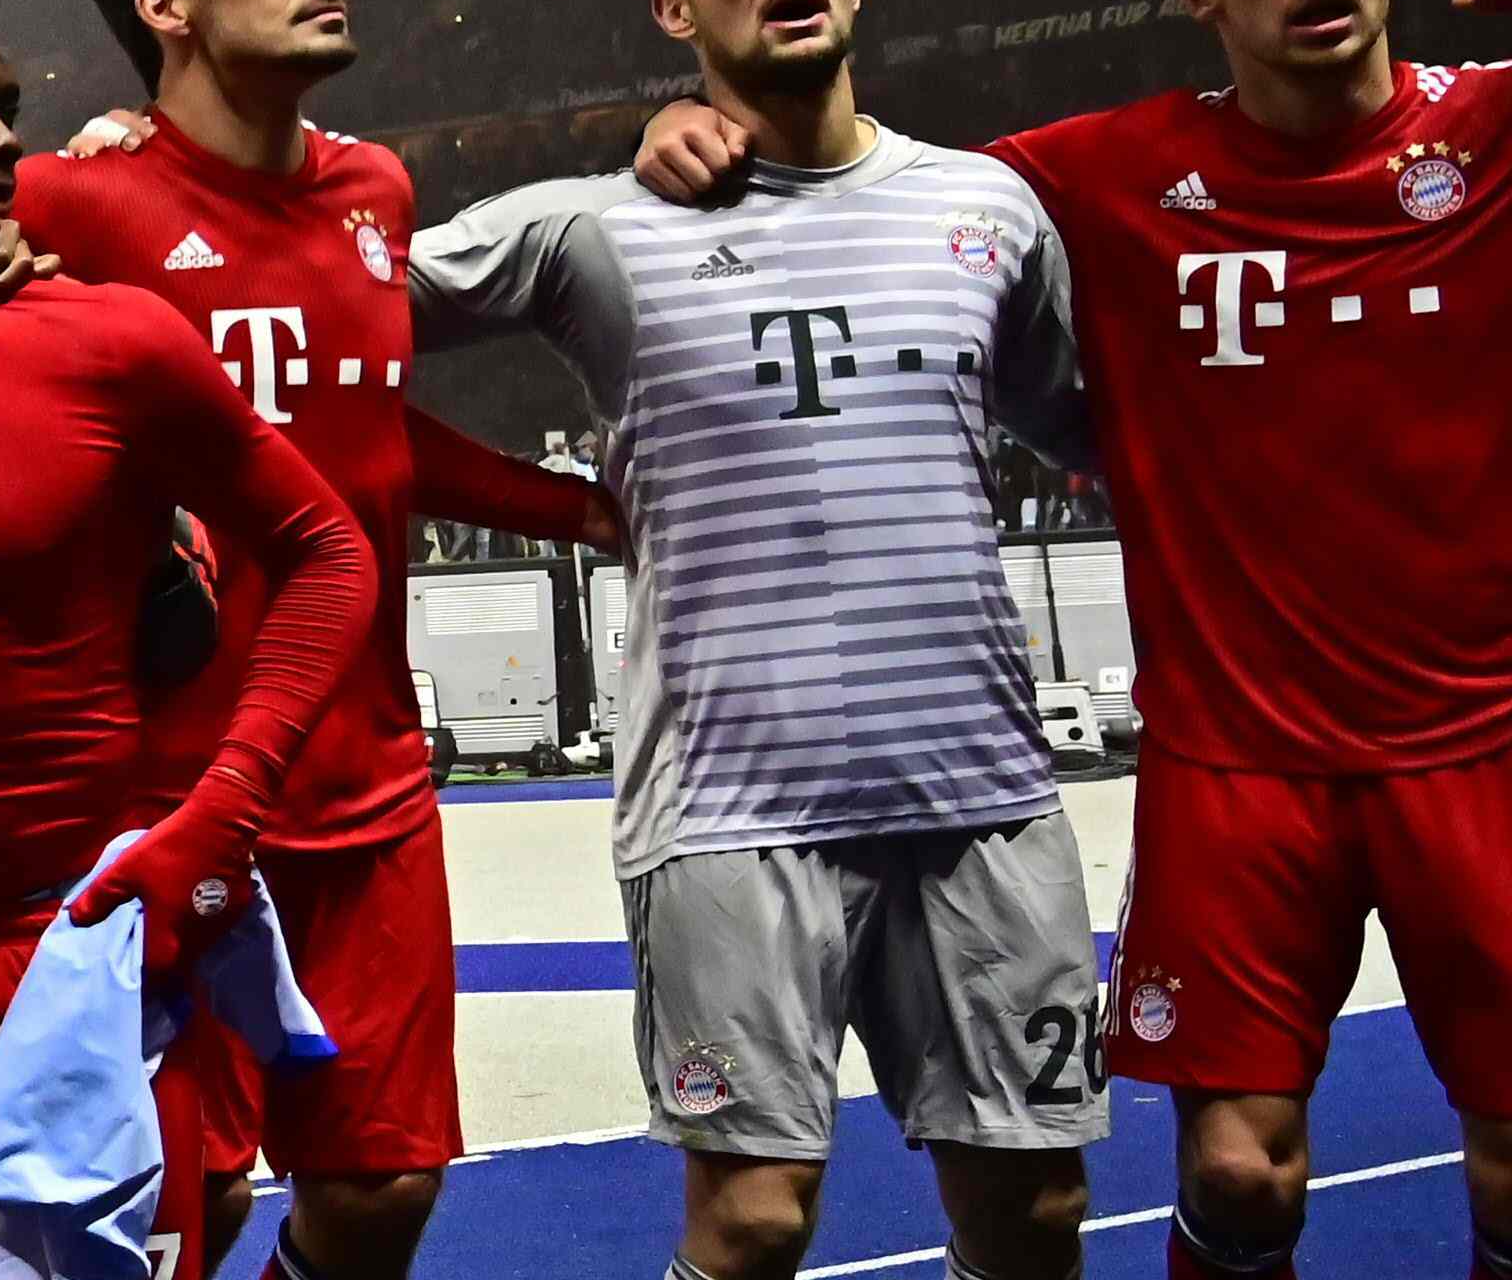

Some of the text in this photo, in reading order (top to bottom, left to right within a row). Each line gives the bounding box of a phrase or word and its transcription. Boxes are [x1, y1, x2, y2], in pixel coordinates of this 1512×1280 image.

[1414, 164, 1460, 185] BAYERN
[1160, 194, 1217, 210] adidas
[164, 246, 224, 271] adidas
[691, 257, 755, 282] adidas
[687, 1061, 722, 1084] BAYERN
